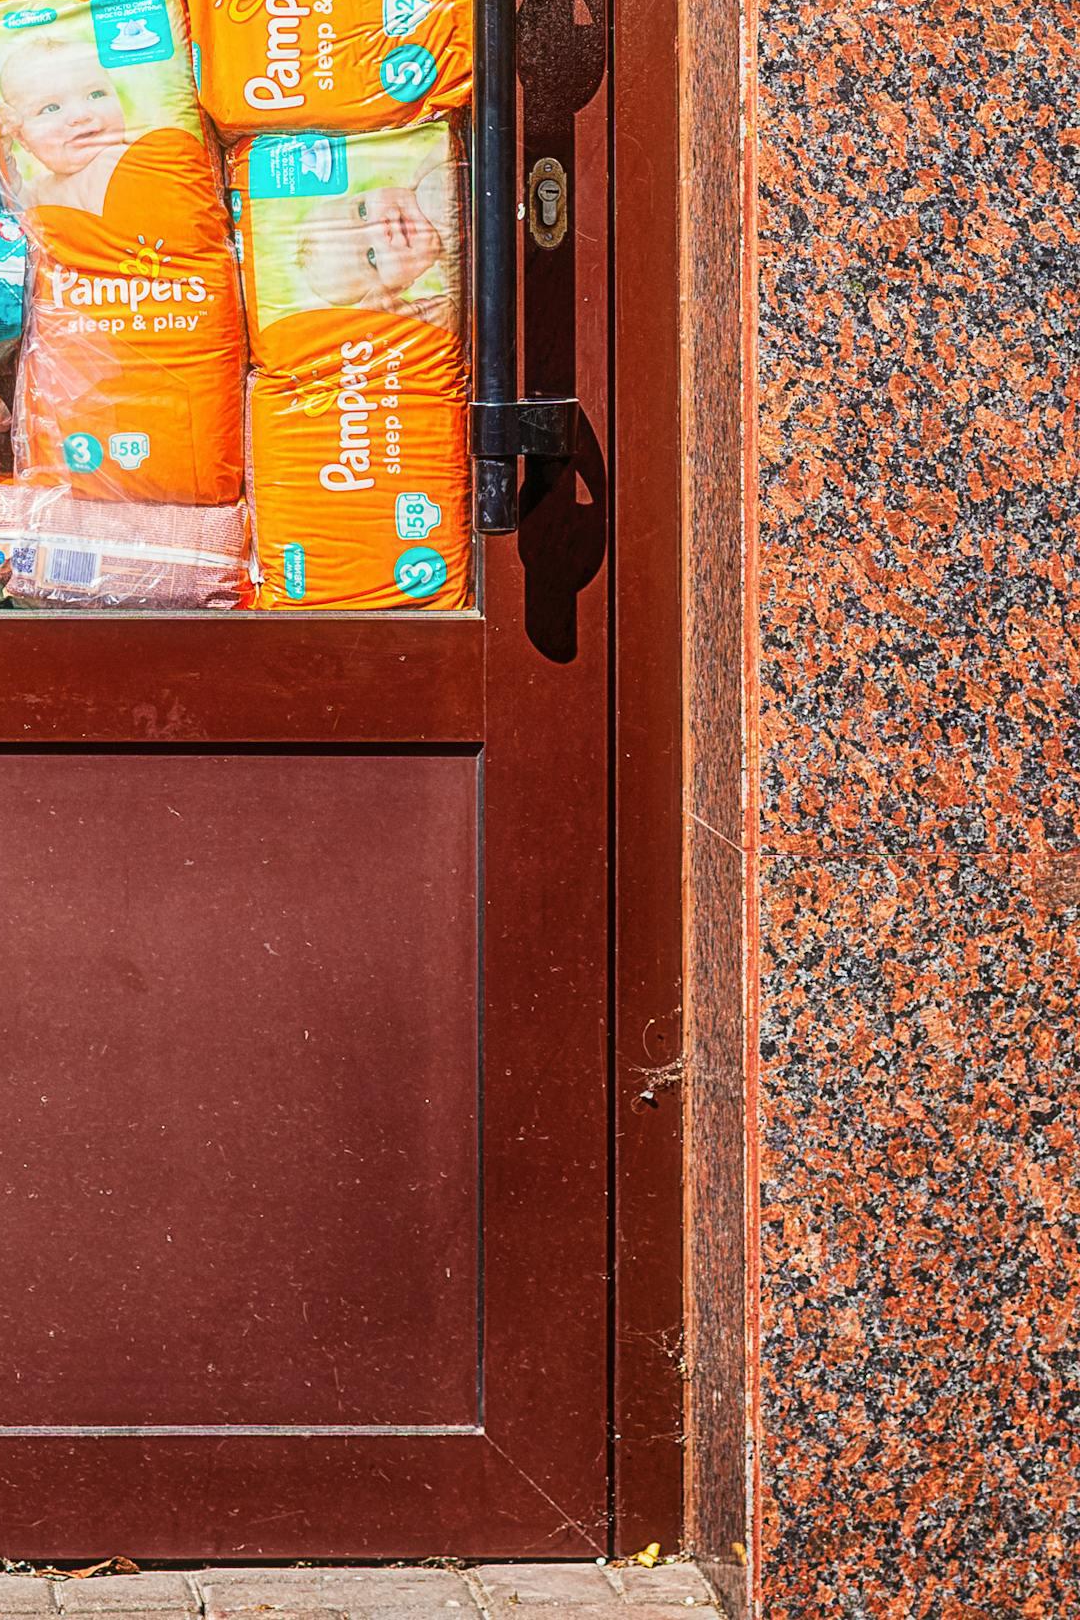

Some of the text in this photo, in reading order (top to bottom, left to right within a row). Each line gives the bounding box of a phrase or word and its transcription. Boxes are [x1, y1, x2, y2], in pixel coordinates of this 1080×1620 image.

[314, 22, 337, 90] sleep
[385, 61, 422, 85] 5
[49, 266, 208, 312] Pampers
[67, 312, 199, 334] sleep & play
[320, 341, 378, 492] Pampers
[381, 347, 404, 474] sleep & play
[71, 436, 140, 463] 3 58
[399, 501, 433, 586] 3 58
